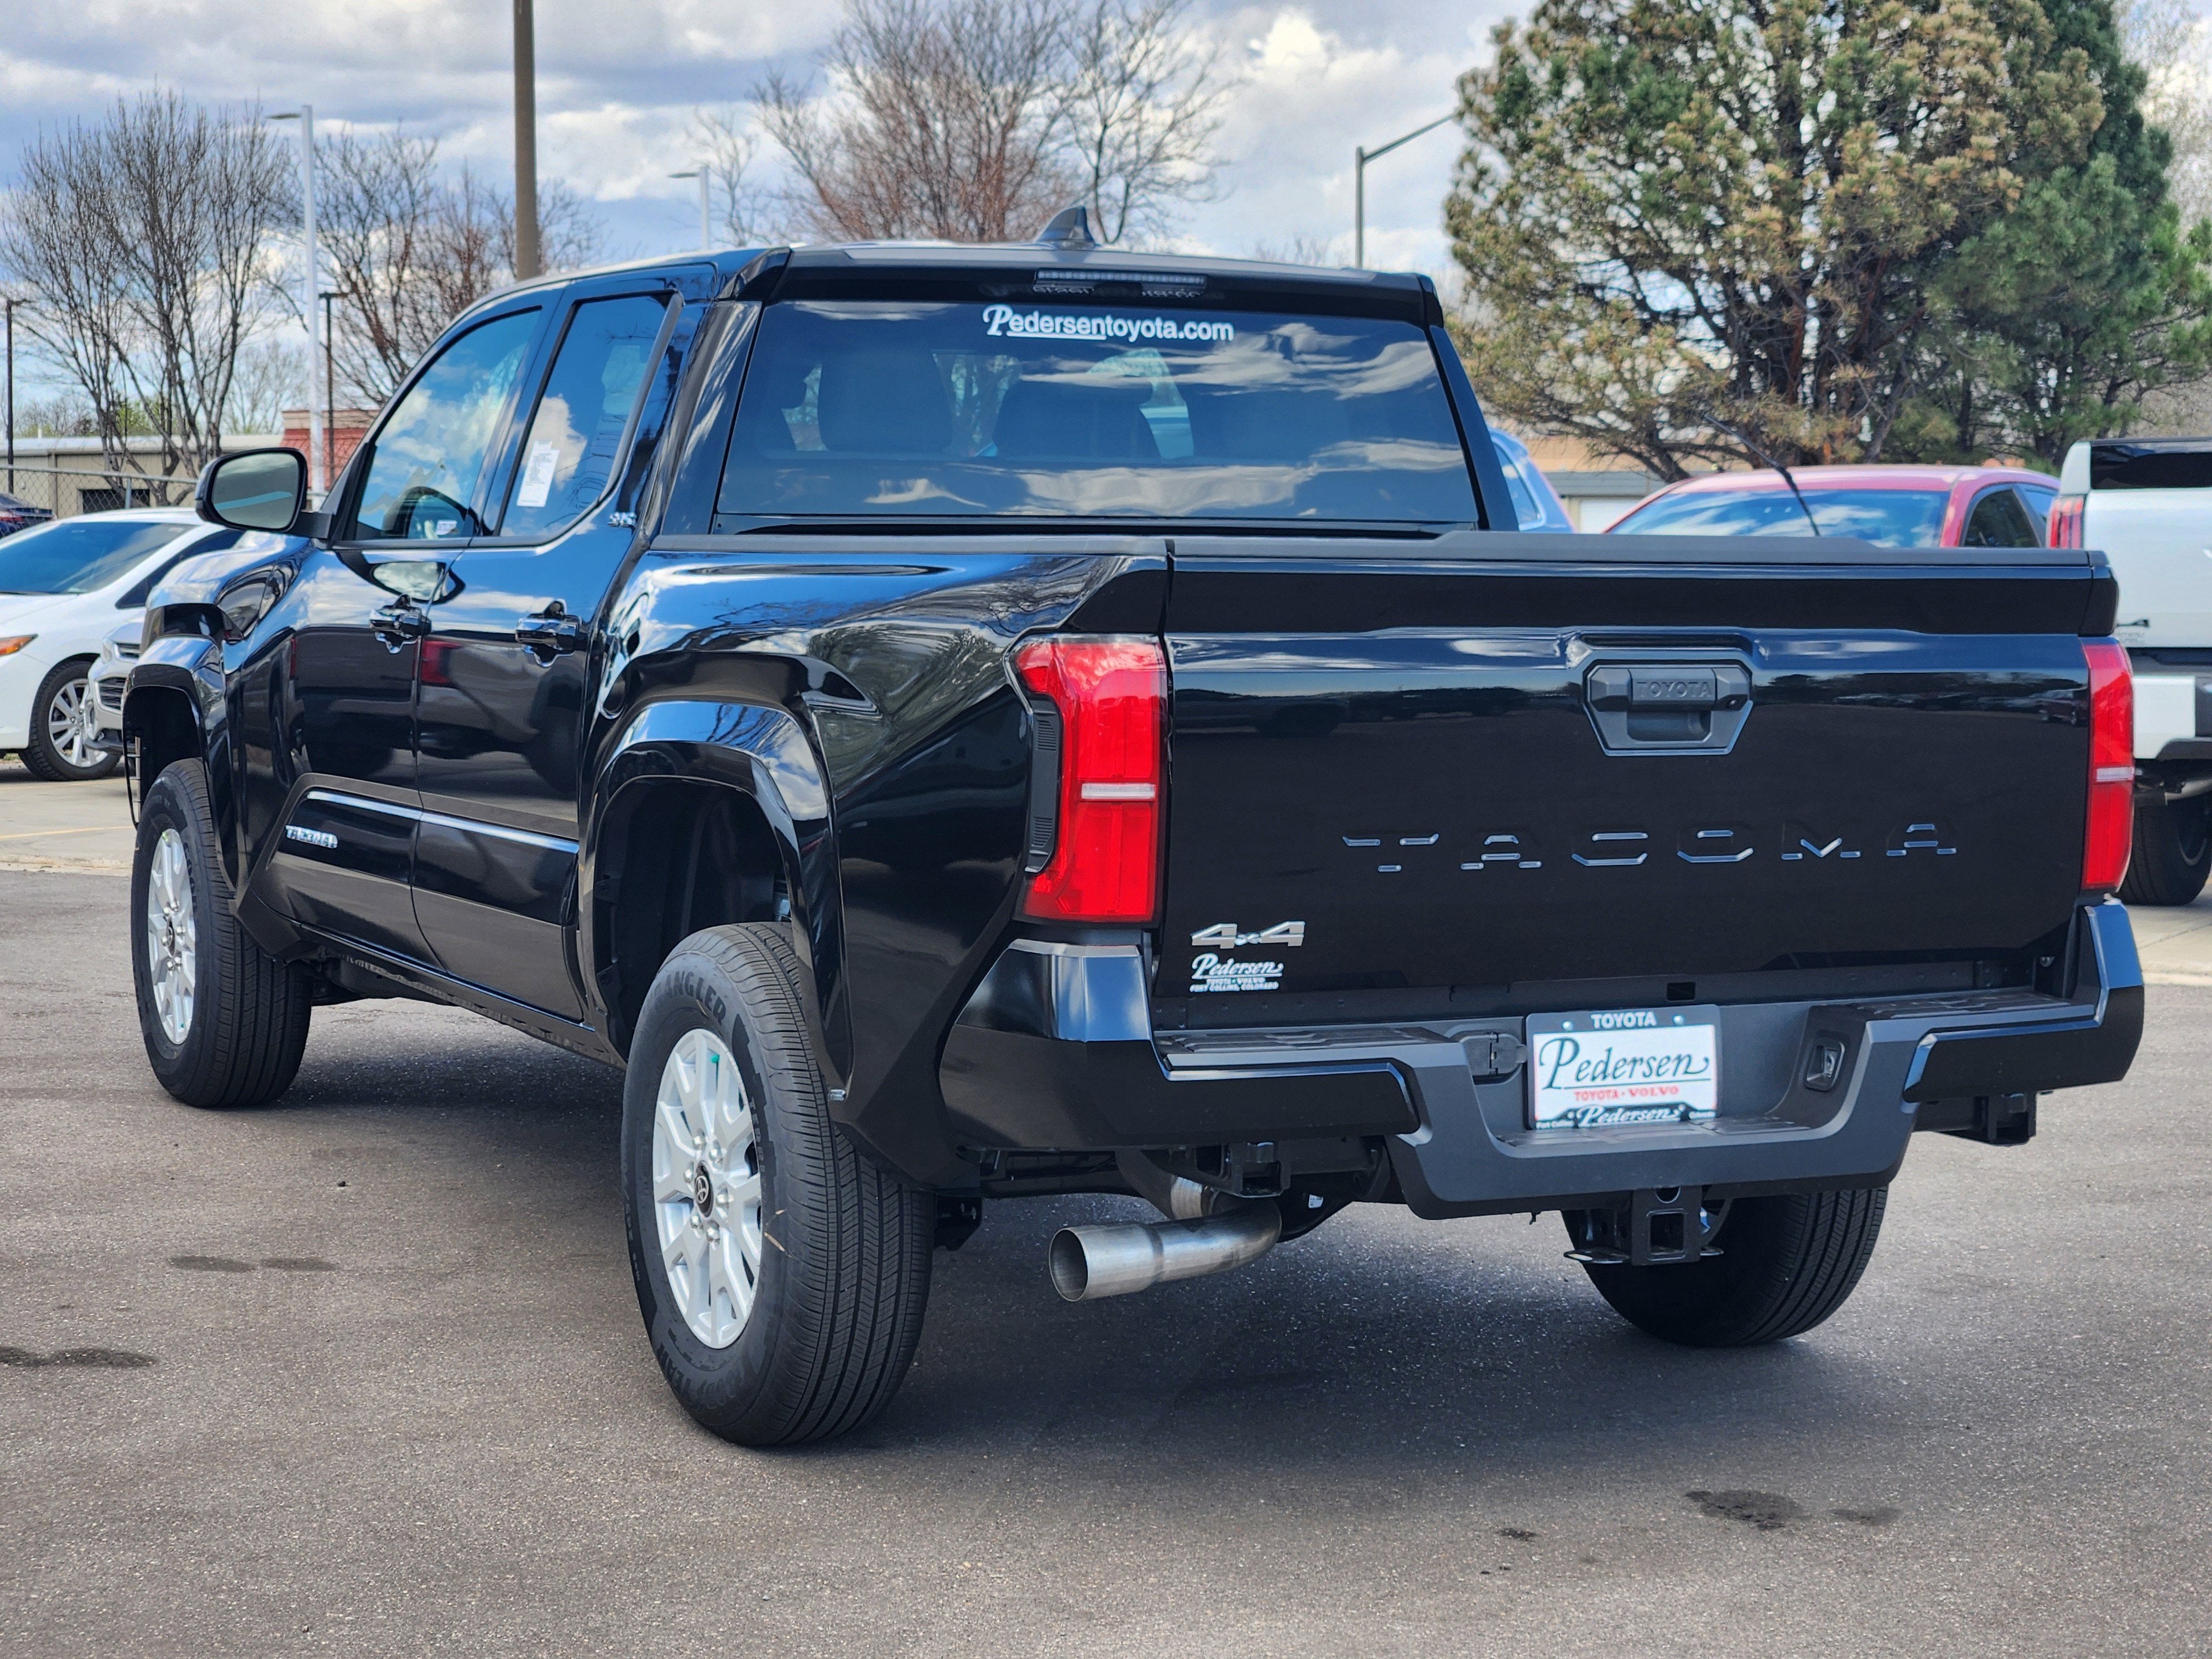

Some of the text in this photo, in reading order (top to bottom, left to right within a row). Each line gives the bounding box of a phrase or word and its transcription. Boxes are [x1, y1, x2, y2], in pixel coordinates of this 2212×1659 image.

[982, 305, 1234, 342] Pedersentoyota.com
[1636, 681, 1712, 698] TOYOTA
[1342, 818, 1959, 873] TACOMA
[1191, 953, 1284, 979] Pedersen
[1590, 1011, 1657, 1029] TOYOTA
[1539, 1036, 1710, 1090] Pedersen
[1574, 1086, 1679, 1101] TOYOTA VOLVO
[1576, 1104, 1679, 1128] Pedersen
